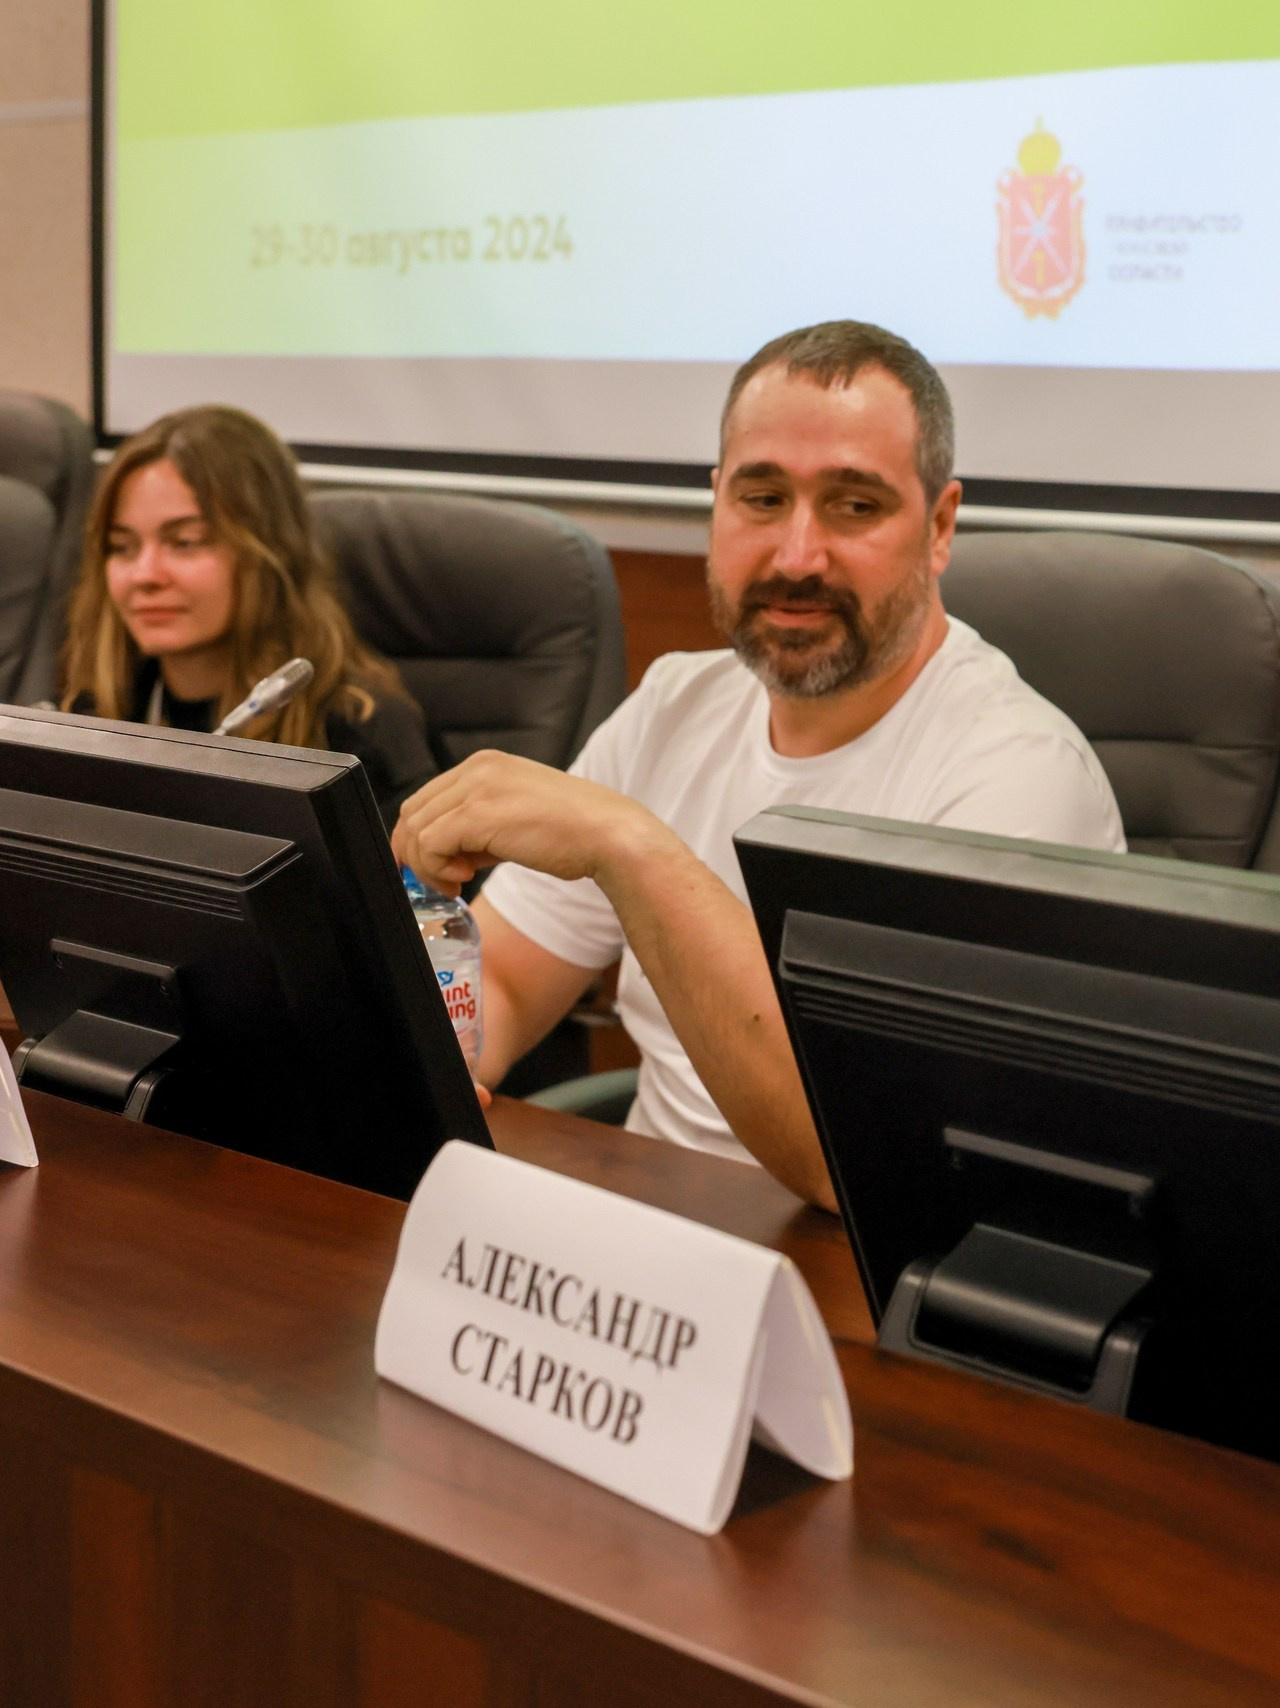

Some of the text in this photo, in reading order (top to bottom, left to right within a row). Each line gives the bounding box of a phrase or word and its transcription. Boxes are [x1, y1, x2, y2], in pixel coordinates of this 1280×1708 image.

[250, 212, 575, 277] 29-30 августа 2024
[449, 998, 476, 1020] ing
[440, 1236, 697, 1376] АЛЕКСАНДР
[449, 1322, 646, 1446] СТАРКОВ
